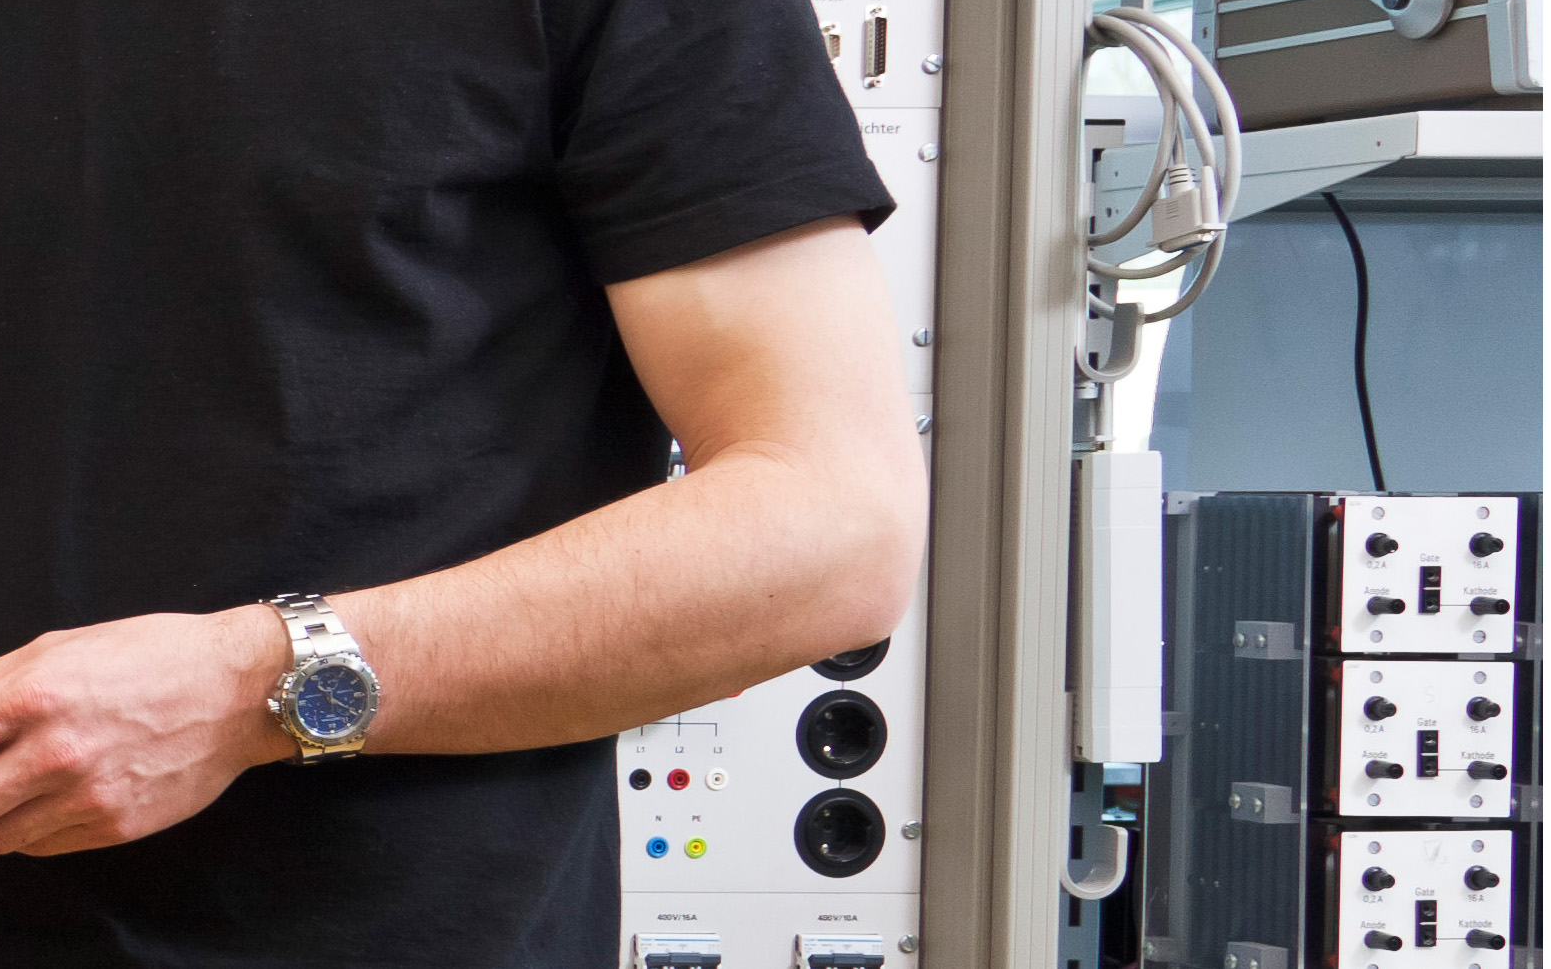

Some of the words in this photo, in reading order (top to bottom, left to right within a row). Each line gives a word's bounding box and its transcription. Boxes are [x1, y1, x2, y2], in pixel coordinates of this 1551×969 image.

[859, 122, 901, 135] ichter
[1463, 586, 1498, 595] Kathode
[675, 746, 685, 754] L2
[1461, 751, 1495, 760] Kathode
[1458, 920, 1492, 928] Kathode
